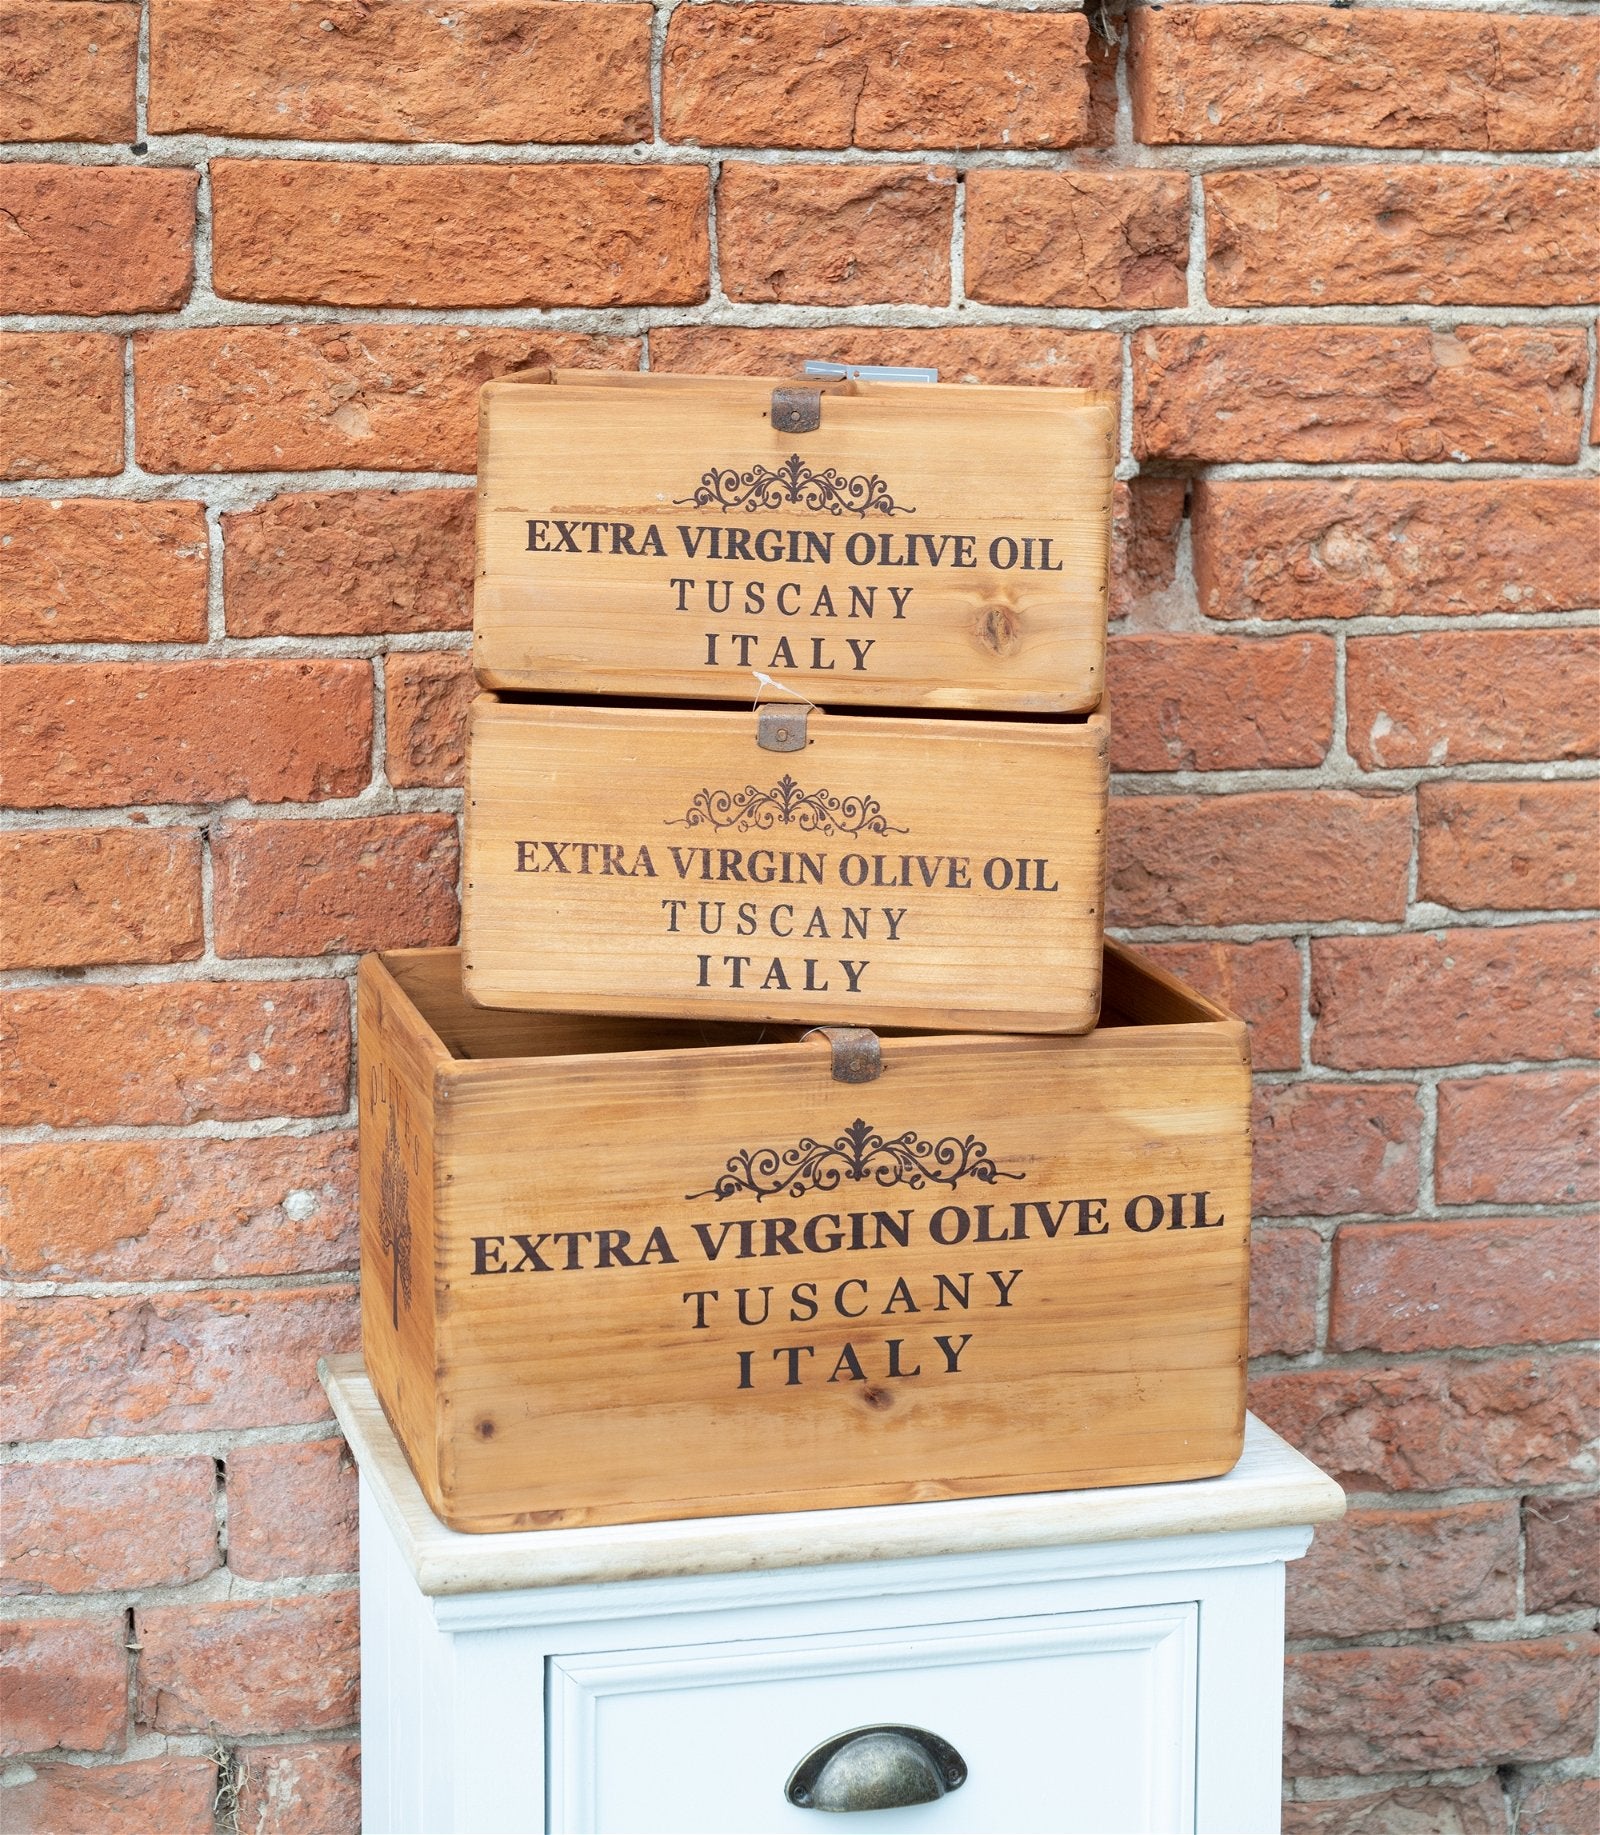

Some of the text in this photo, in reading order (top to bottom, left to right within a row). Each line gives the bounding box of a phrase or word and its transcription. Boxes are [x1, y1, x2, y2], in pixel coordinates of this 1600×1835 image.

[525, 519, 1063, 571] EXTRA VIRGIN OLIVE OIL
[670, 578, 914, 619] TUSCANY
[704, 633, 876, 671] ITALY
[514, 840, 1059, 892] EXTRA VIRGIN OLIVE OIL
[661, 899, 908, 940] TUSCANY
[696, 954, 870, 993] ITALY
[370, 1062, 421, 1176] OLIVES
[470, 1190, 1225, 1276] EXTRA VIRGIN OLIVE OIL
[682, 1269, 1024, 1329] TUSCANY
[736, 1333, 974, 1390] ITALY
